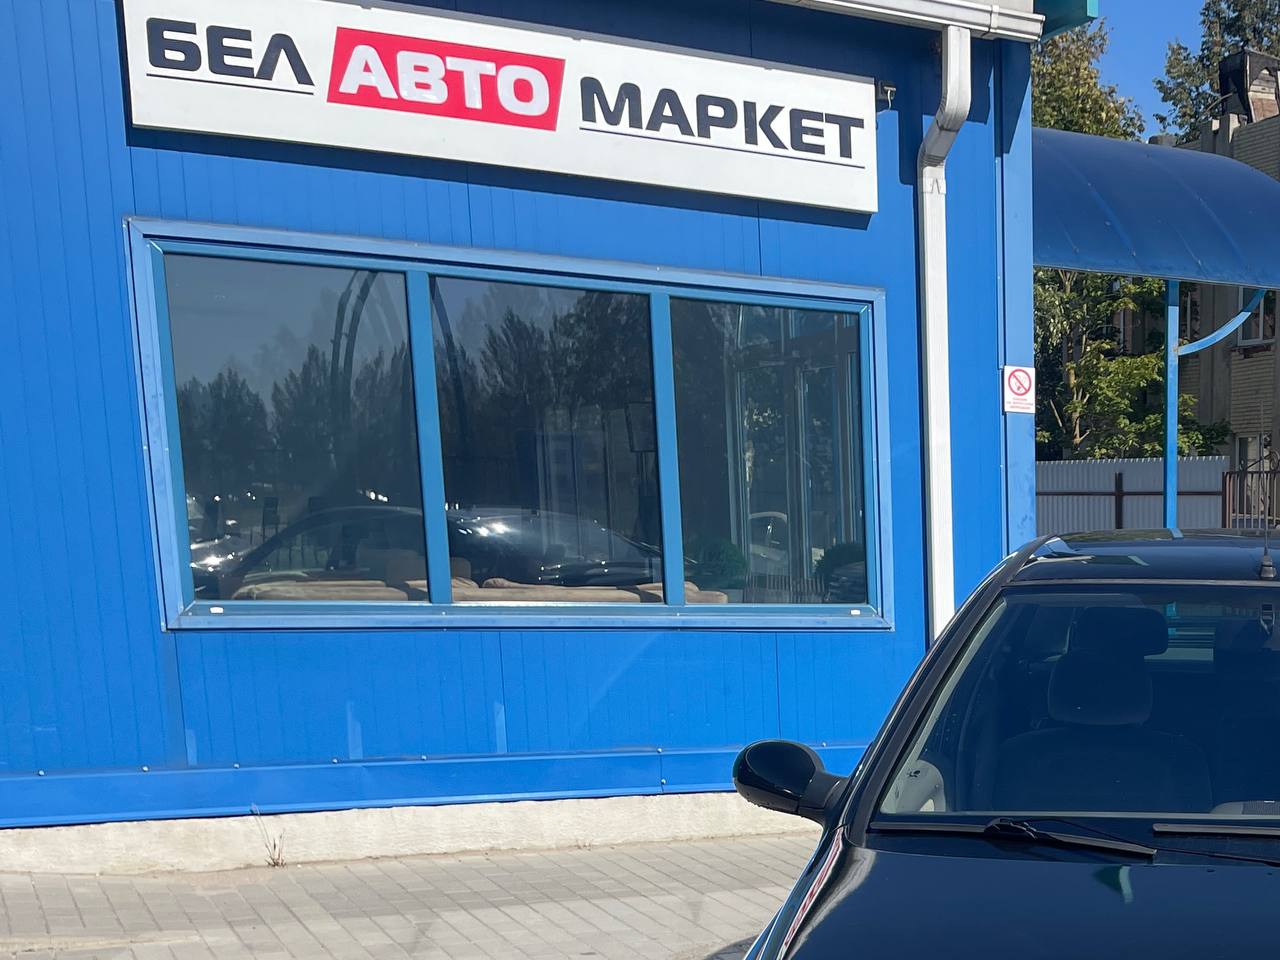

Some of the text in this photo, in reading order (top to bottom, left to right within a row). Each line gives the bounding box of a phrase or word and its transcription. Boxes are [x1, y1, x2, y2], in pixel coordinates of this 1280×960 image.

[146, 17, 865, 161] БЕЛ АВТО МАРКЕТ
